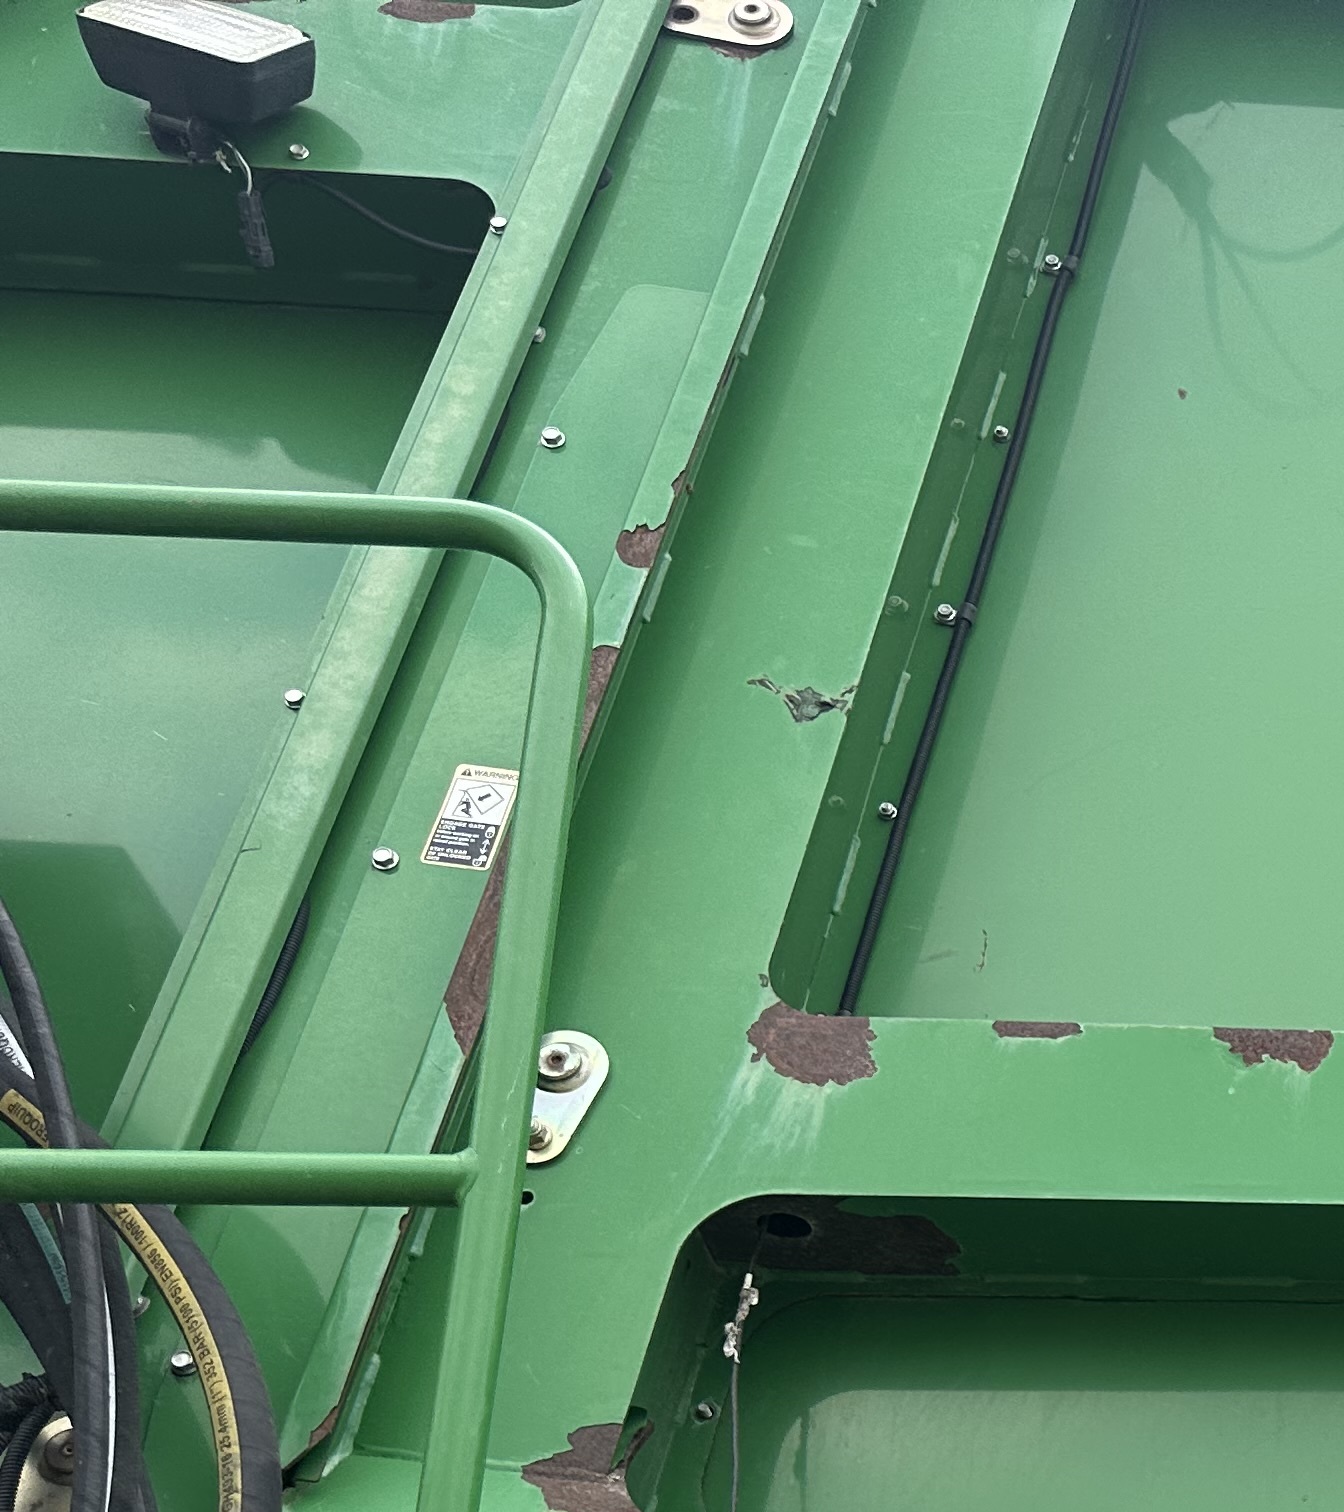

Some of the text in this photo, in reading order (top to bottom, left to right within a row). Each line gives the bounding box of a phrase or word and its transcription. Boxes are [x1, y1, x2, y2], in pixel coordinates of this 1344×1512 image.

[8, 1102, 48, 1144] EROQUIP
[192, 1333, 212, 1360] BAR
[202, 1360, 218, 1382] 352
